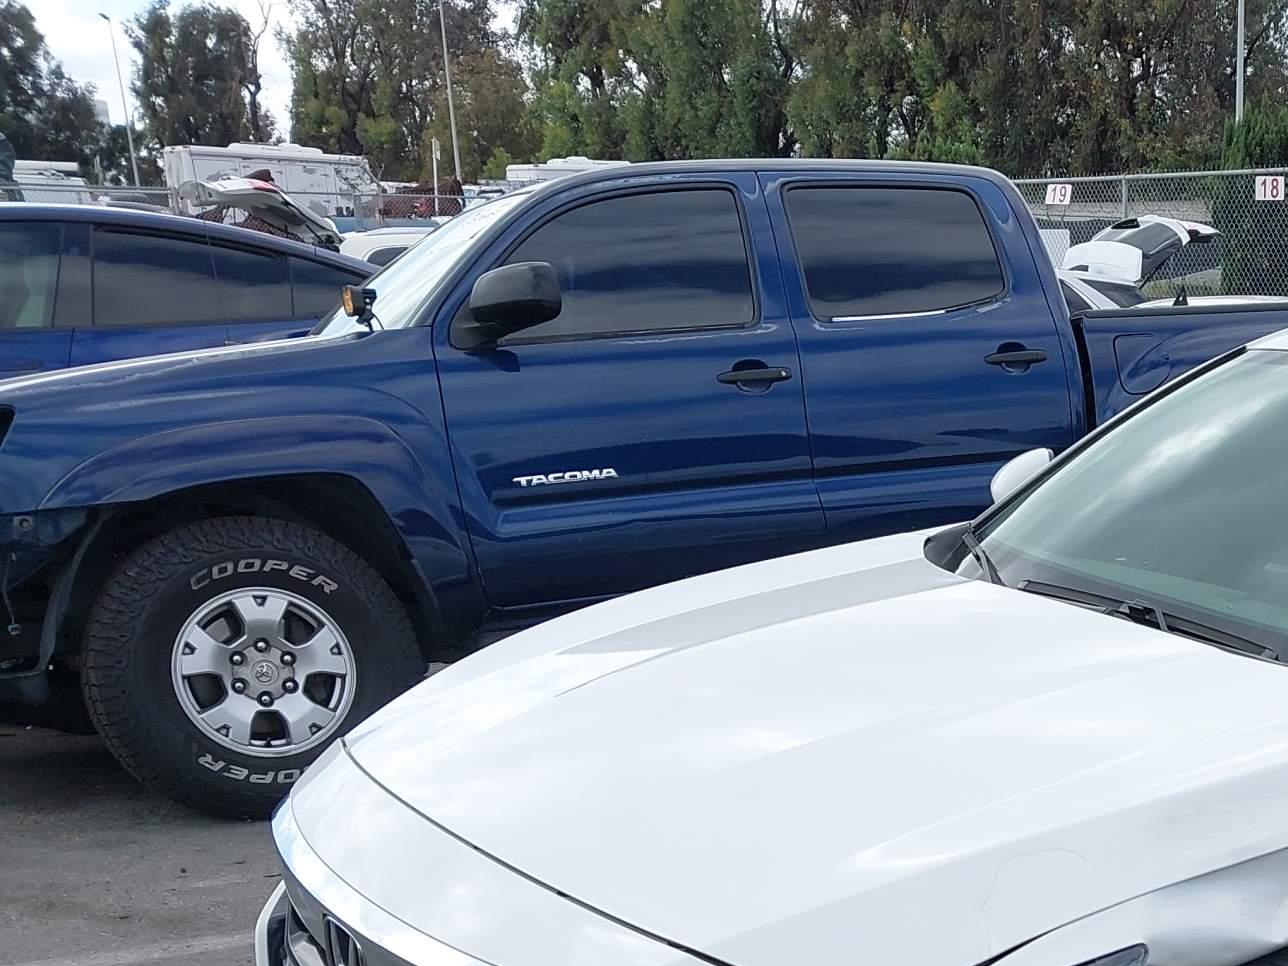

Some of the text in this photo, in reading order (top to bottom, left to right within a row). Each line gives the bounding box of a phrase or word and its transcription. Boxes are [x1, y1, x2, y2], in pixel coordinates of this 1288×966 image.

[1050, 185, 1068, 203] 19
[1260, 178, 1280, 199] 18
[512, 468, 619, 487] TACOMA
[189, 558, 339, 594] COOPER
